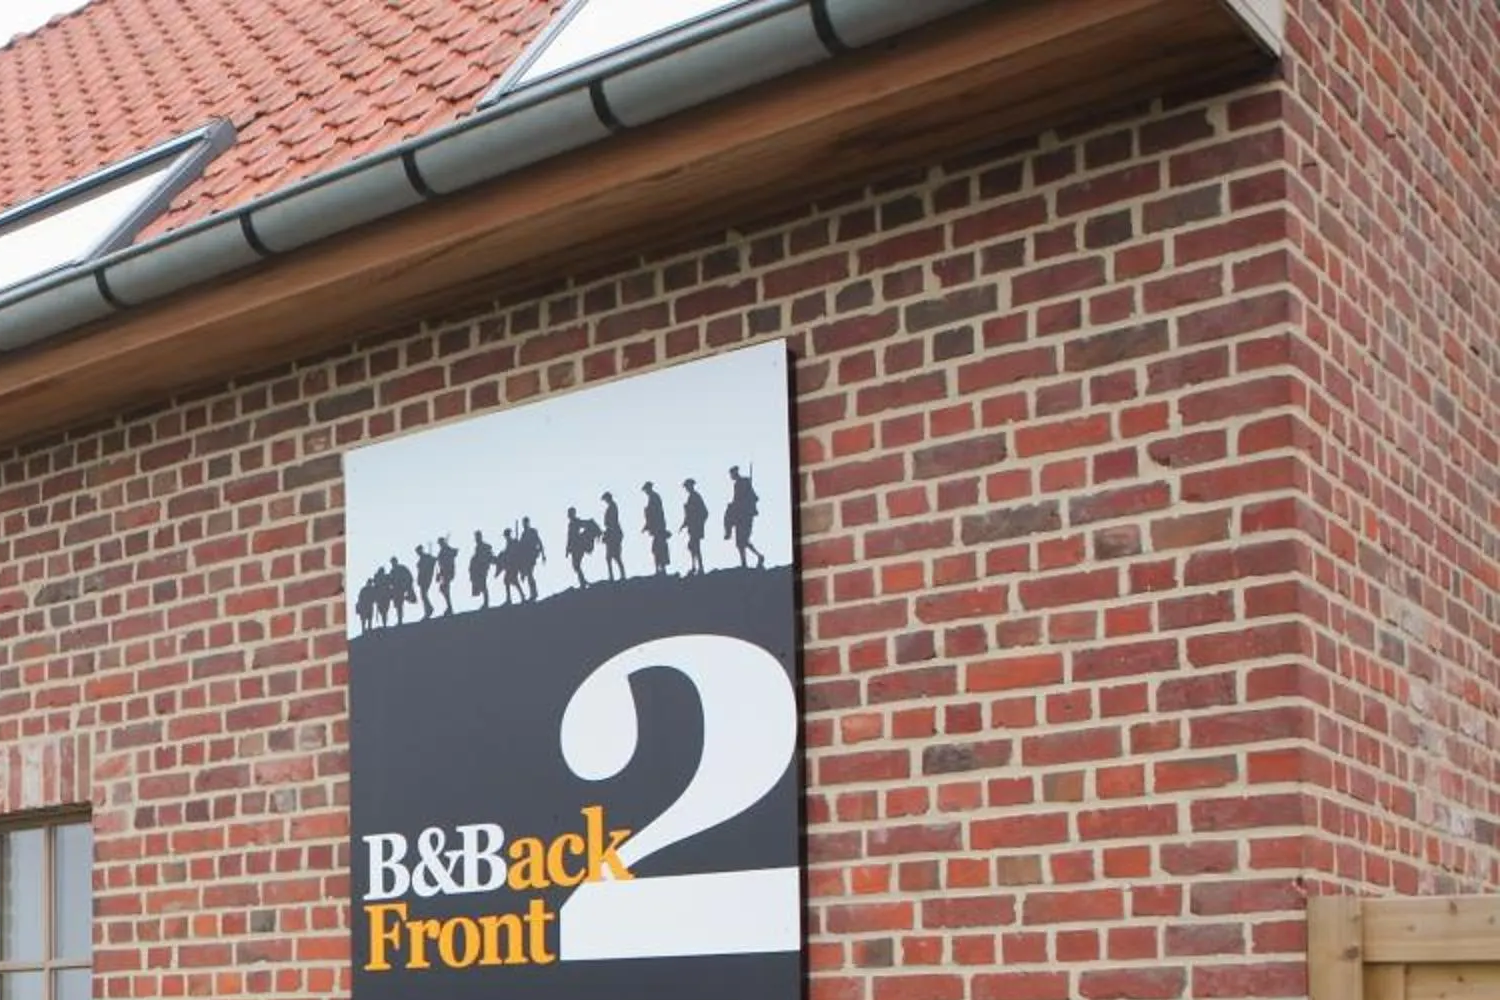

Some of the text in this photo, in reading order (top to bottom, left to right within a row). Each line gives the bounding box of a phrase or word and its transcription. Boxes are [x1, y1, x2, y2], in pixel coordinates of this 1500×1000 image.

[560, 634, 800, 960] 2
[363, 806, 635, 901] B&Back
[364, 899, 555, 970] Front
